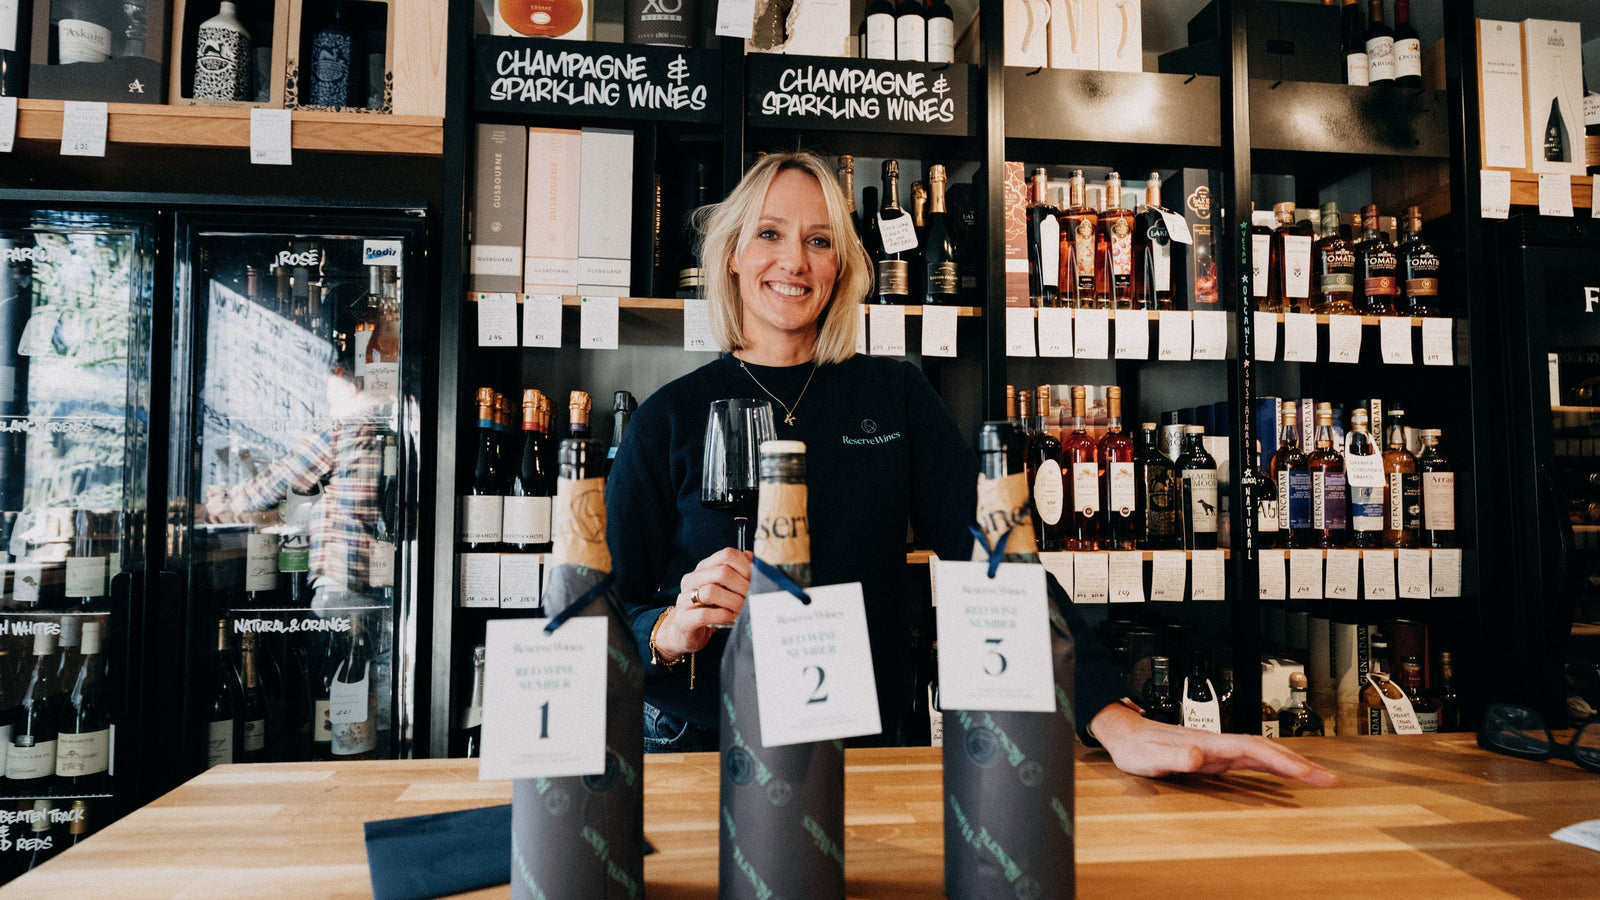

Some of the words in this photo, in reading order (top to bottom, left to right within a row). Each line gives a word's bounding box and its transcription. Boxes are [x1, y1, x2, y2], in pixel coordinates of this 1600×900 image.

[496, 47, 648, 82] CHAMPAGNE
[667, 53, 690, 86] &
[779, 65, 928, 99] CHAMPAGNE
[932, 73, 951, 99] &
[489, 77, 621, 107] SPARKLING
[627, 81, 708, 111] WINES
[761, 90, 881, 120] SPARKLING
[886, 97, 955, 123] WINES
[493, 152, 503, 209] GUSBOURNE
[549, 162, 559, 222] GUSBOURNE
[365, 247, 397, 257] Prodis
[476, 256, 514, 264] GUSBOURNE
[586, 268, 622, 276] GUSBOURNE
[1242, 285, 1250, 356] ORGANIC
[1279, 471, 1289, 528] GLENCADAM
[1314, 472, 1323, 528] GLENCADAM
[1391, 473, 1400, 529] GLENCADAM
[1244, 486, 1253, 560] NATURAL
[11, 620, 61, 637] WHITES
[233, 618, 289, 634] NATURAL
[289, 617, 301, 633] &
[301, 617, 352, 634] ORANGE
[983, 638, 1007, 677] 3
[1359, 627, 1369, 685] GLENCADAM
[802, 664, 829, 705] 2
[538, 700, 550, 740] 1
[0, 808, 48, 824] BEATEN
[50, 808, 85, 824] TRACK
[16, 836, 54, 852] REDS
